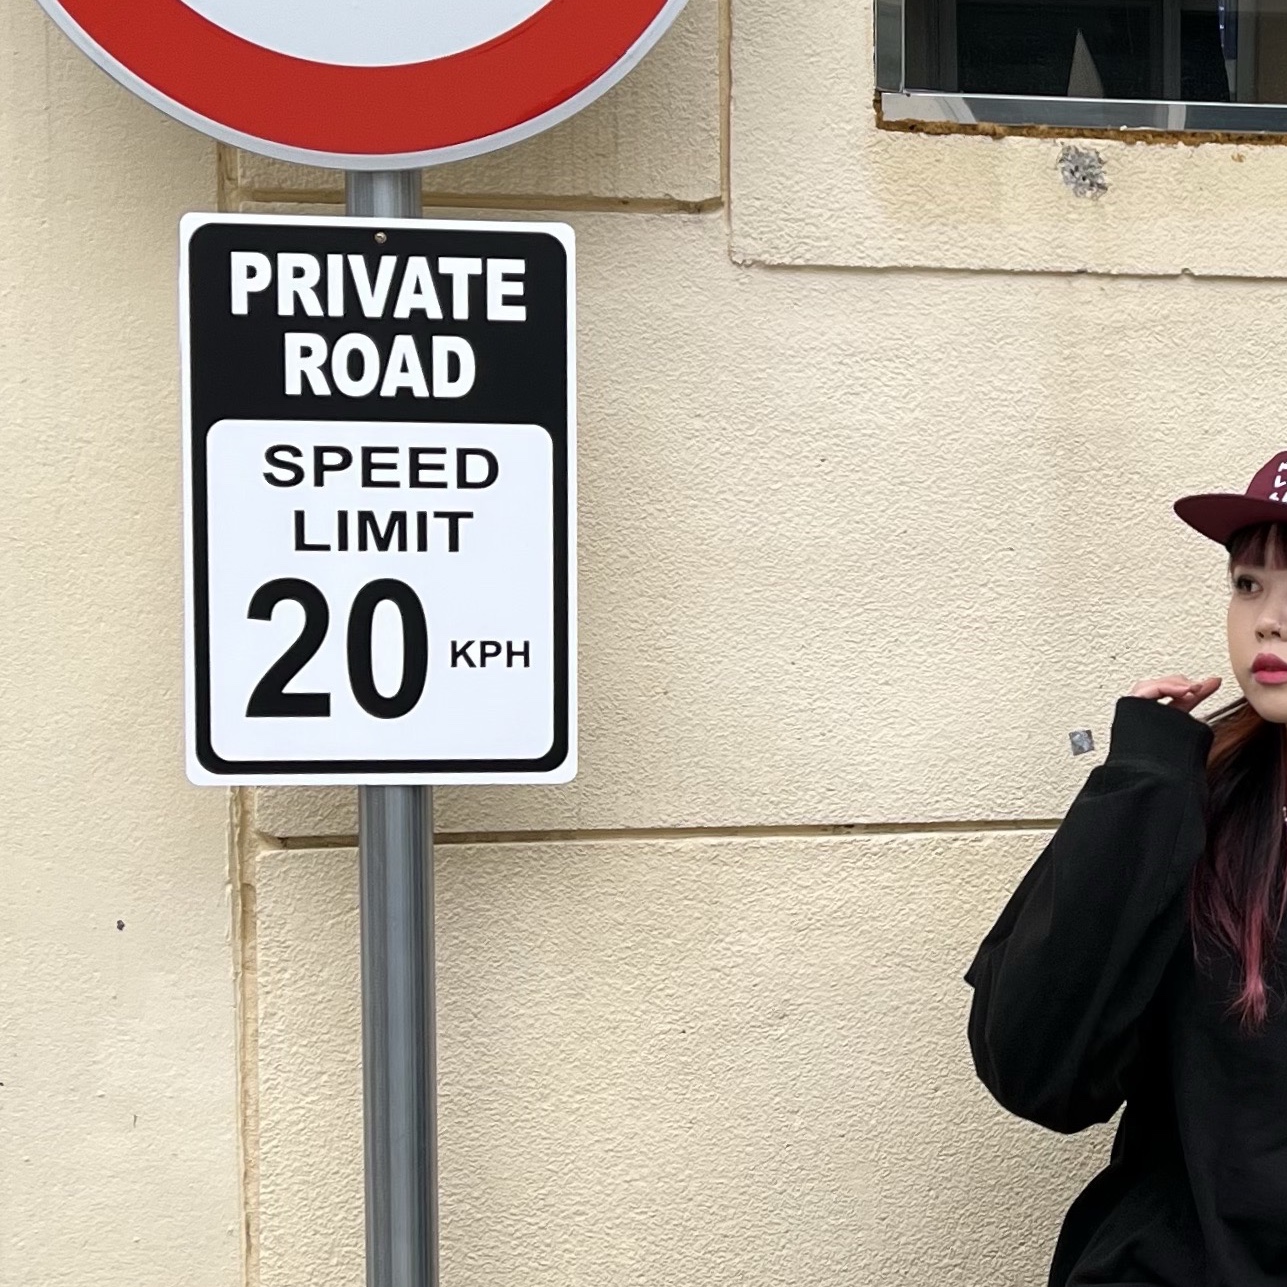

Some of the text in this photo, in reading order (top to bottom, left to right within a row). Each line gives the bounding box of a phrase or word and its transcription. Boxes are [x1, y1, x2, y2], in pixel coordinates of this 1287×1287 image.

[229, 251, 527, 321] PRIVATE
[284, 333, 477, 399] ROAD
[261, 445, 500, 490] SPEED
[293, 510, 475, 554] LIMIT
[245, 577, 532, 720] 20 KPH
